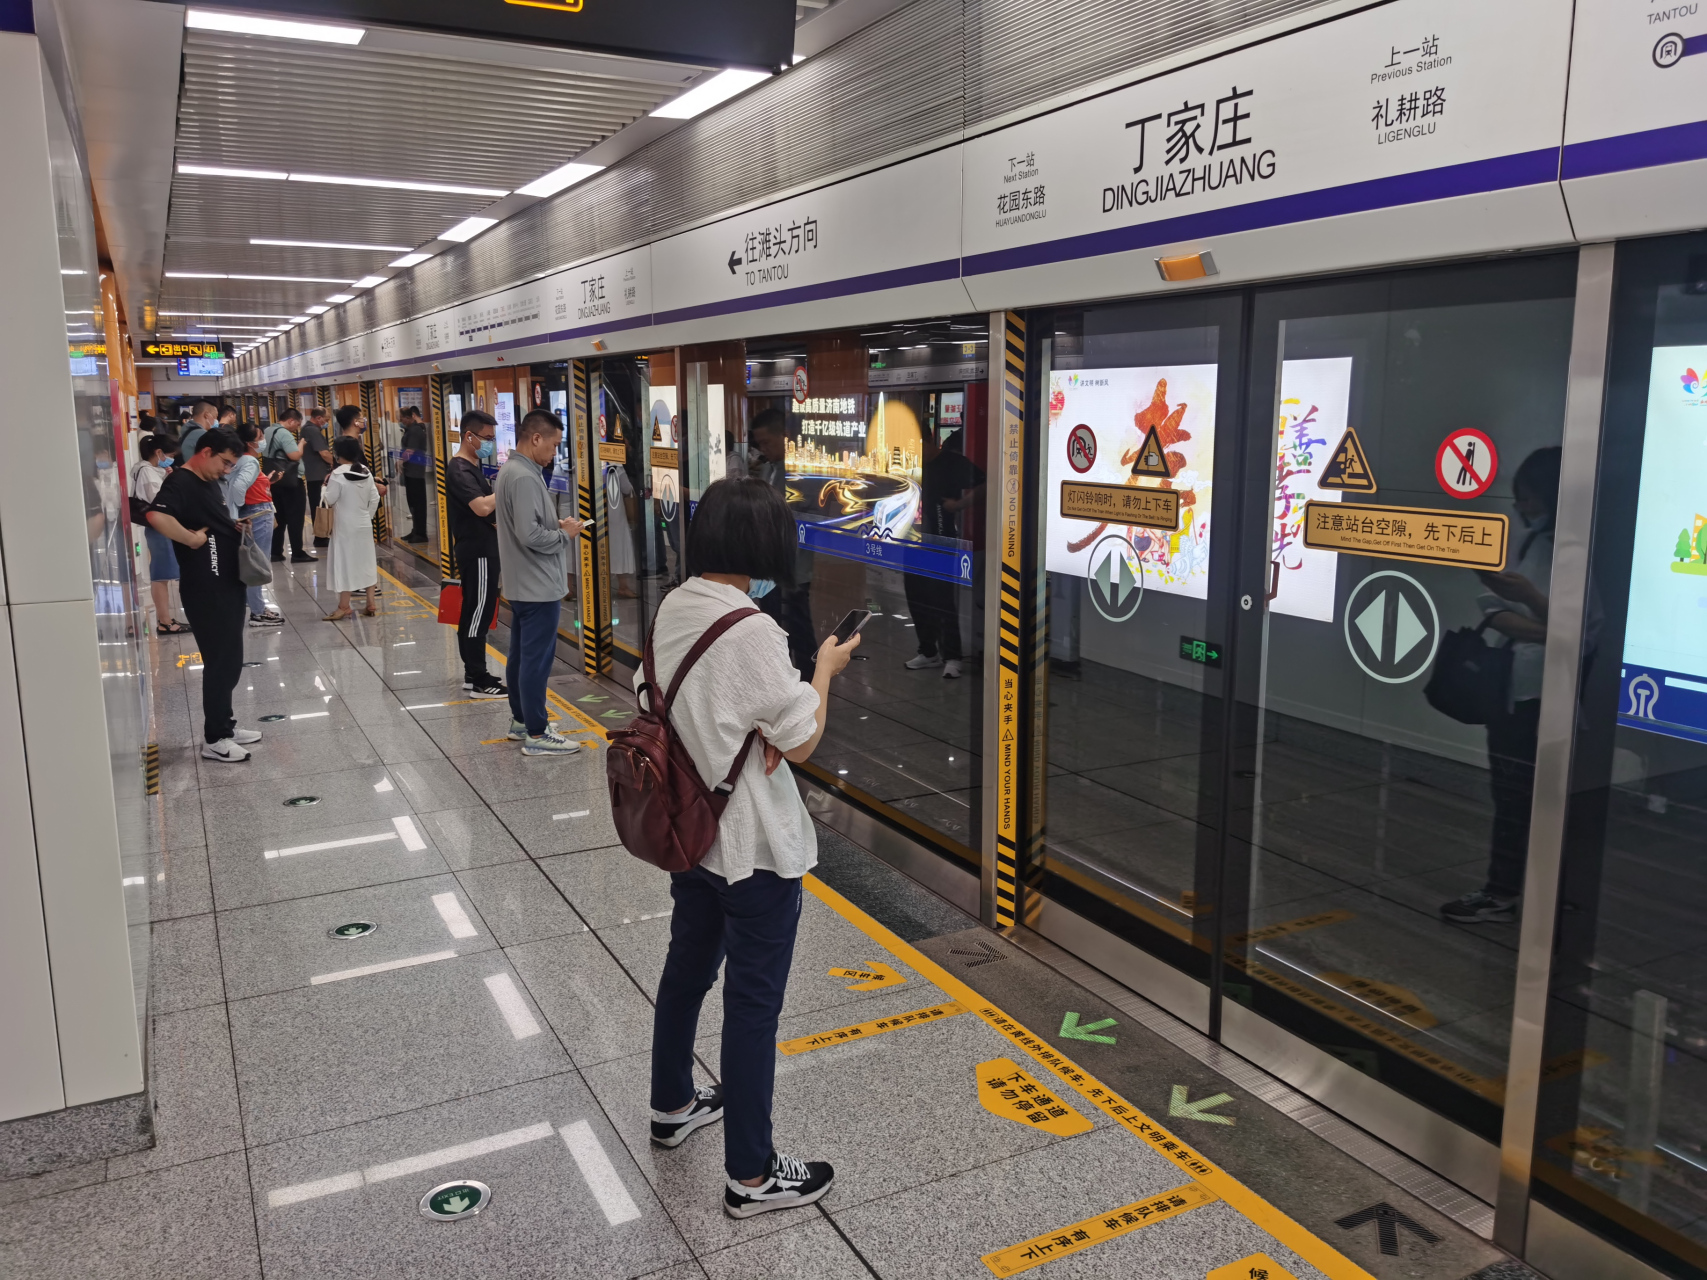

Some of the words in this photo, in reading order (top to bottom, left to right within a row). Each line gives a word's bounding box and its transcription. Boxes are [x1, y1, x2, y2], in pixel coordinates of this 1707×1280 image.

[1646, 3, 1698, 25] TANTOU
[1384, 34, 1440, 68] 上一站
[1370, 66, 1413, 84] Previous
[1416, 56, 1452, 73] Station
[1371, 85, 1446, 130] 礼耕路
[1125, 86, 1254, 175] 丁家庄
[1377, 122, 1437, 145] LIGENGLU
[1003, 172, 1017, 184] Next
[1018, 167, 1039, 182] Station
[1007, 151, 1035, 172] 下一站
[1102, 149, 1277, 213] DINGJIAZHUANG
[997, 184, 1046, 215] 花园东路
[995, 209, 1047, 228] HUAYUANDONGLU
[745, 216, 817, 265] 往滩头方向
[581, 274, 605, 304] 丁家庄
[745, 270, 756, 286] TO
[757, 263, 789, 284] TANTOU
[1008, 424, 1019, 475] 禁止倚靠
[1008, 497, 1017, 511] NO
[1067, 489, 1173, 513] 灯闪铃响时，请勿上下车
[1007, 514, 1016, 558] LEANING
[1315, 512, 1494, 548] 注意站台空隙，先下后上
[866, 542, 883, 557] 3号线
[1003, 678, 1013, 725] 当心夹手
[1004, 744, 1012, 767] MIND
[1003, 798, 1011, 830] HANDS
[843, 970, 886, 981] 候车区
[876, 1008, 944, 1030] 请排队候车
[806, 1028, 863, 1046] 有序上下
[986, 1077, 1050, 1124] 请勿停留
[992, 1016, 1192, 1162] 请在黄线外排队候车，先下后上文明乘车
[1006, 1071, 1069, 1119] 下车通道
[1103, 1194, 1188, 1231] 请排队候车
[1020, 1228, 1091, 1260] 有序上下
